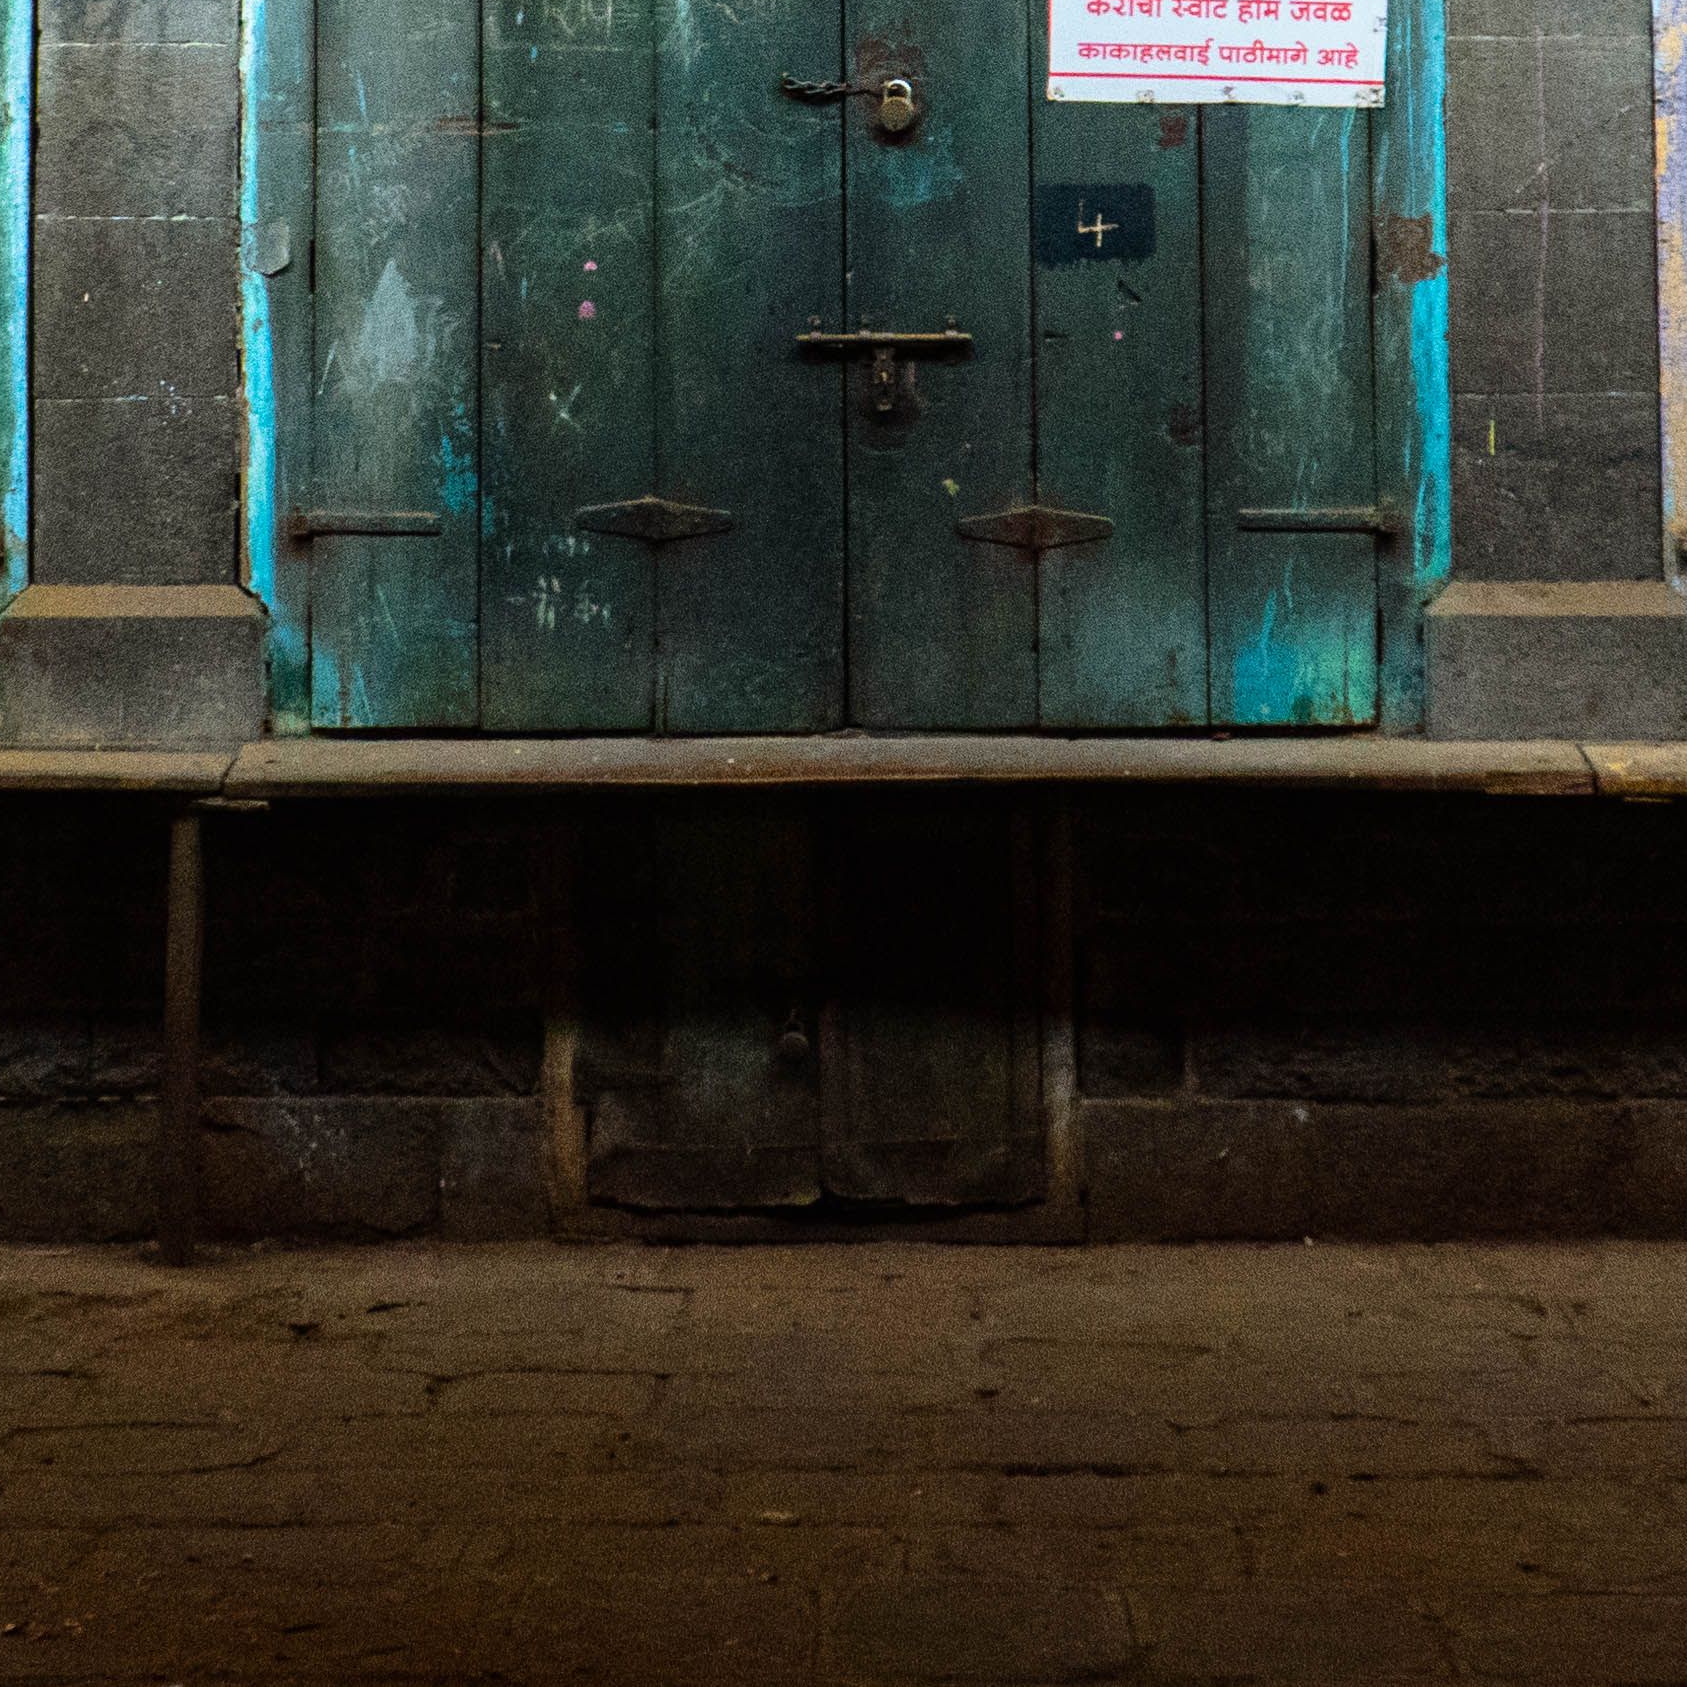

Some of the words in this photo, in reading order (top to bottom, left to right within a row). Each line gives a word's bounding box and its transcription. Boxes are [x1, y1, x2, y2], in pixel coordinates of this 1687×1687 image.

[1078, 37, 1214, 67] काकाहलवाई
[1219, 41, 1309, 67] पाठीमागे
[1317, 42, 1359, 69] आहे
